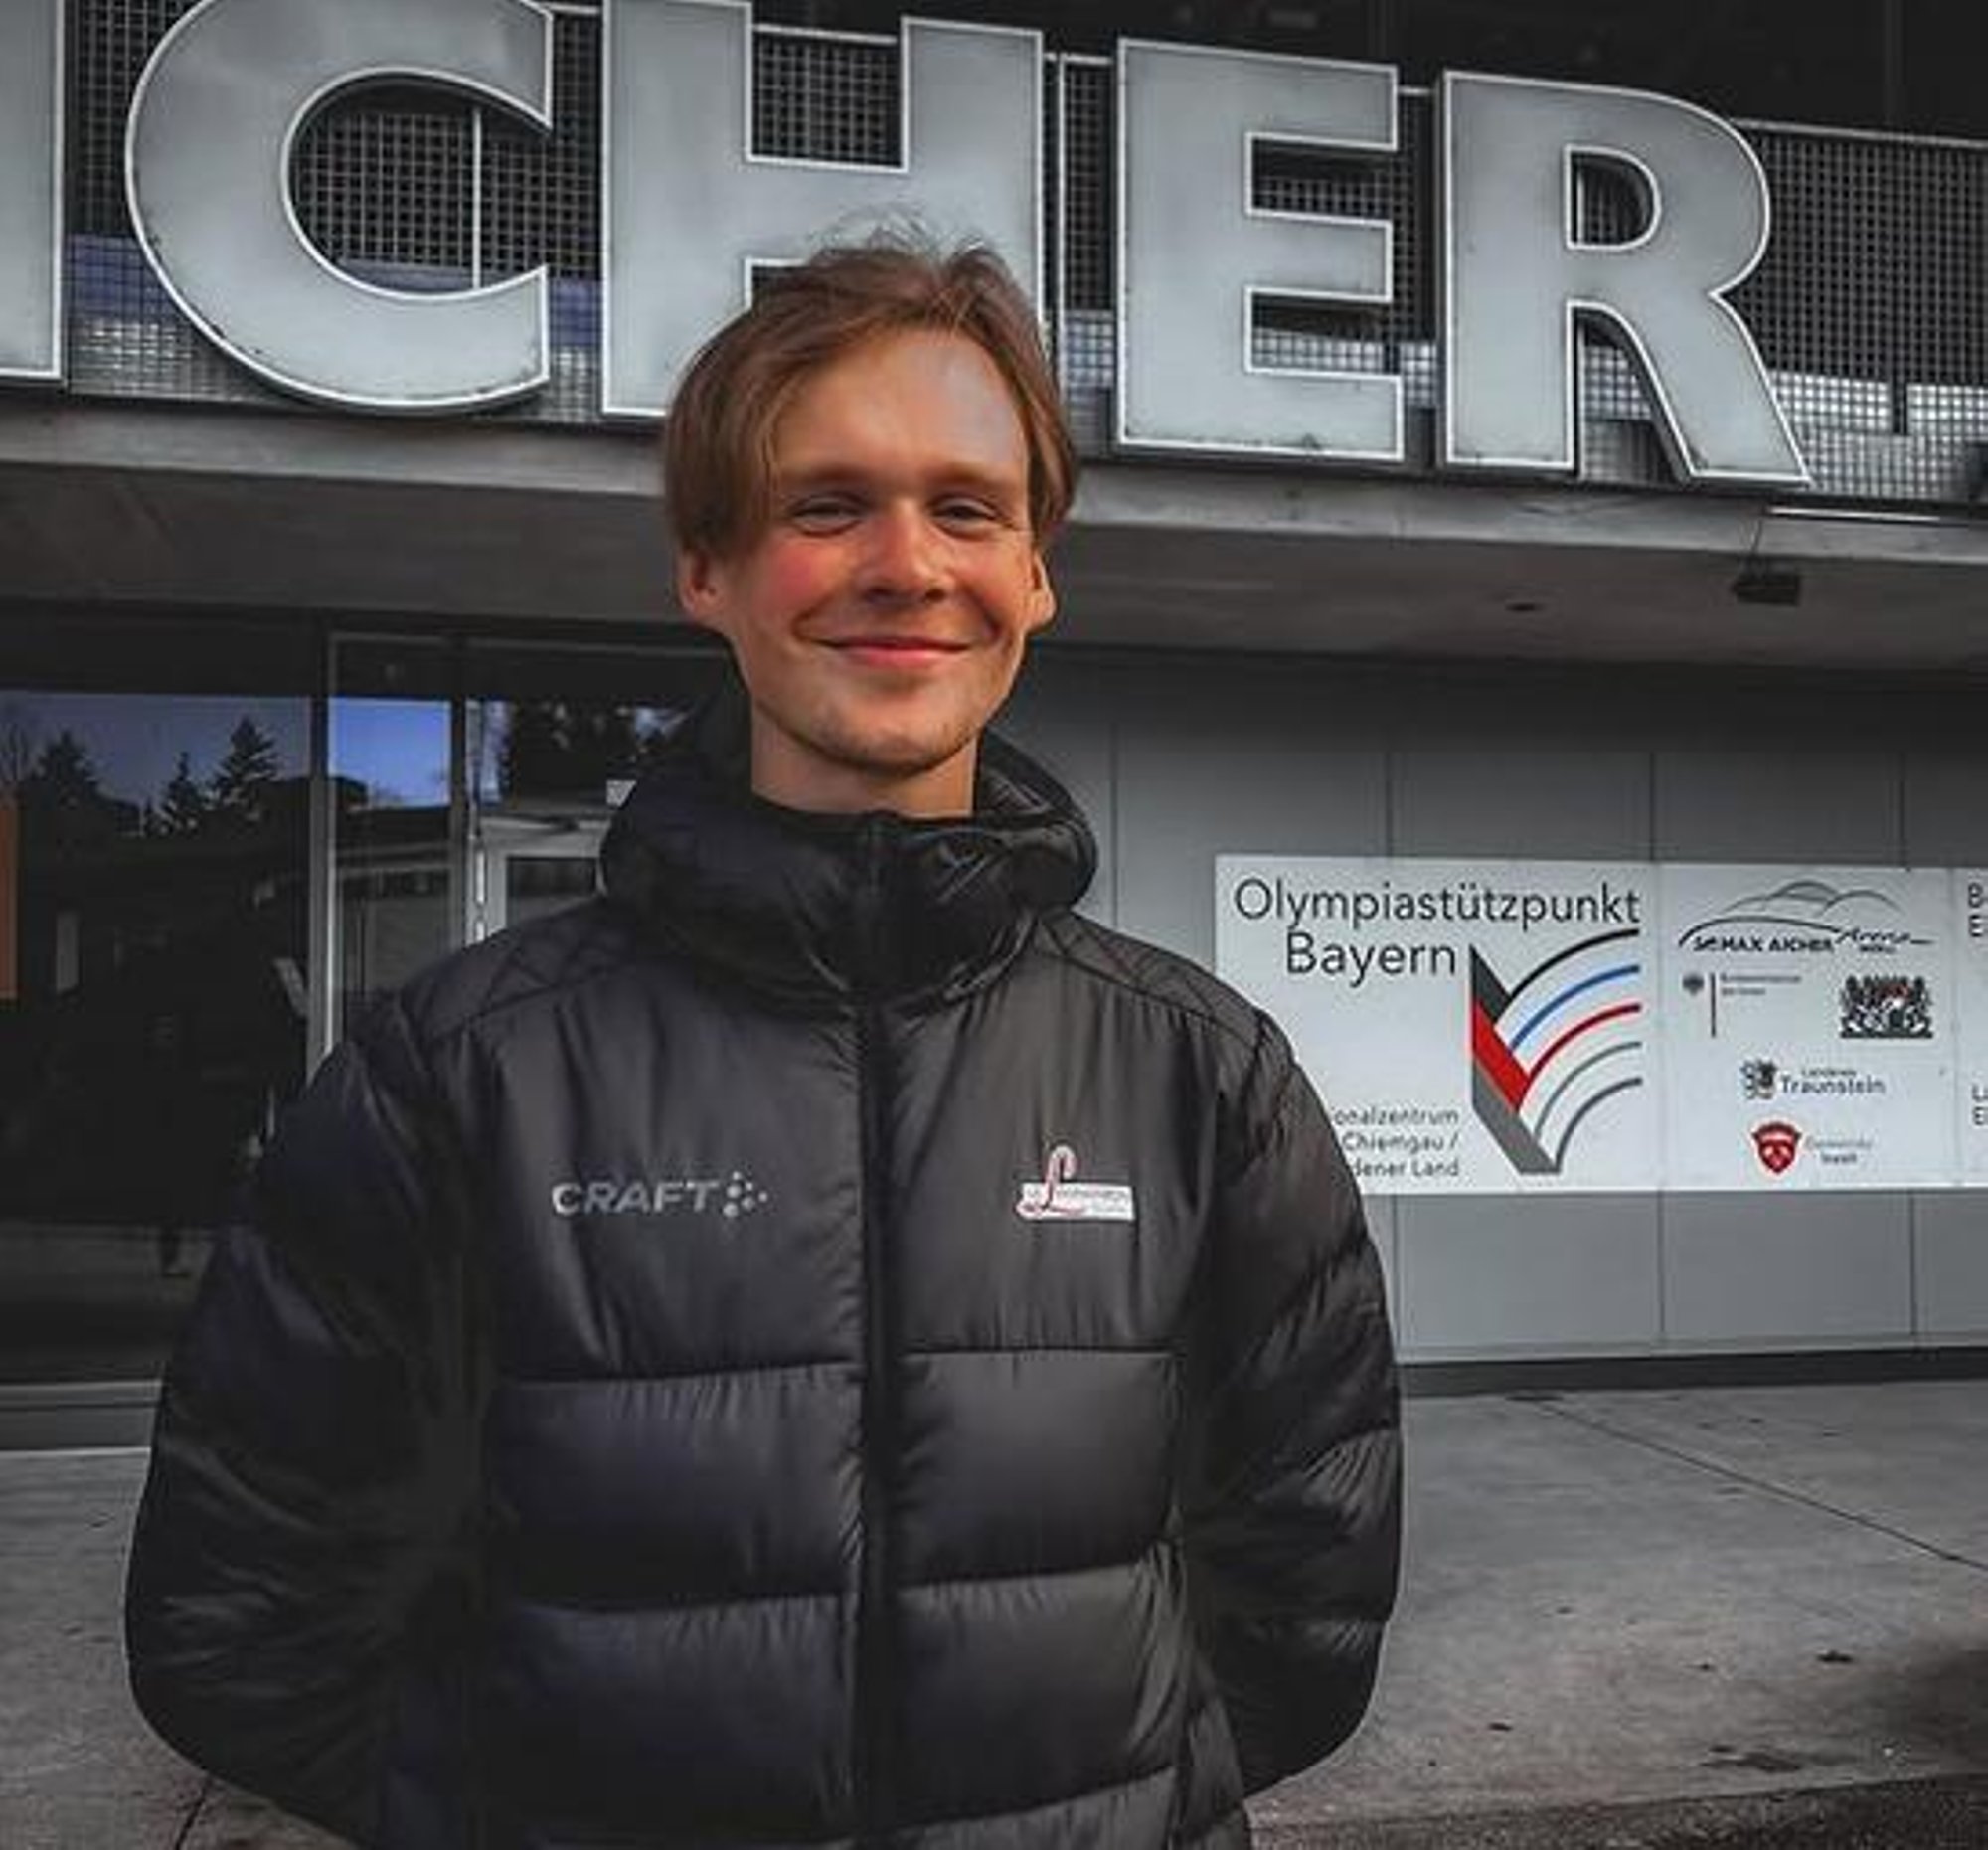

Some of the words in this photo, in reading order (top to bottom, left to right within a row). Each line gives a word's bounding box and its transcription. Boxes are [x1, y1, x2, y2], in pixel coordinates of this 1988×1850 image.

[1234, 878, 1640, 930] Olympiastützpunkt
[1286, 931, 1456, 987] Bayern
[1782, 1074, 1886, 1095] Traunstein
[1330, 1106, 1459, 1126] onalzentrum
[1342, 1132, 1444, 1155] Chiemgau
[1411, 1157, 1459, 1176] Land
[551, 1181, 722, 1215] CRAFT
